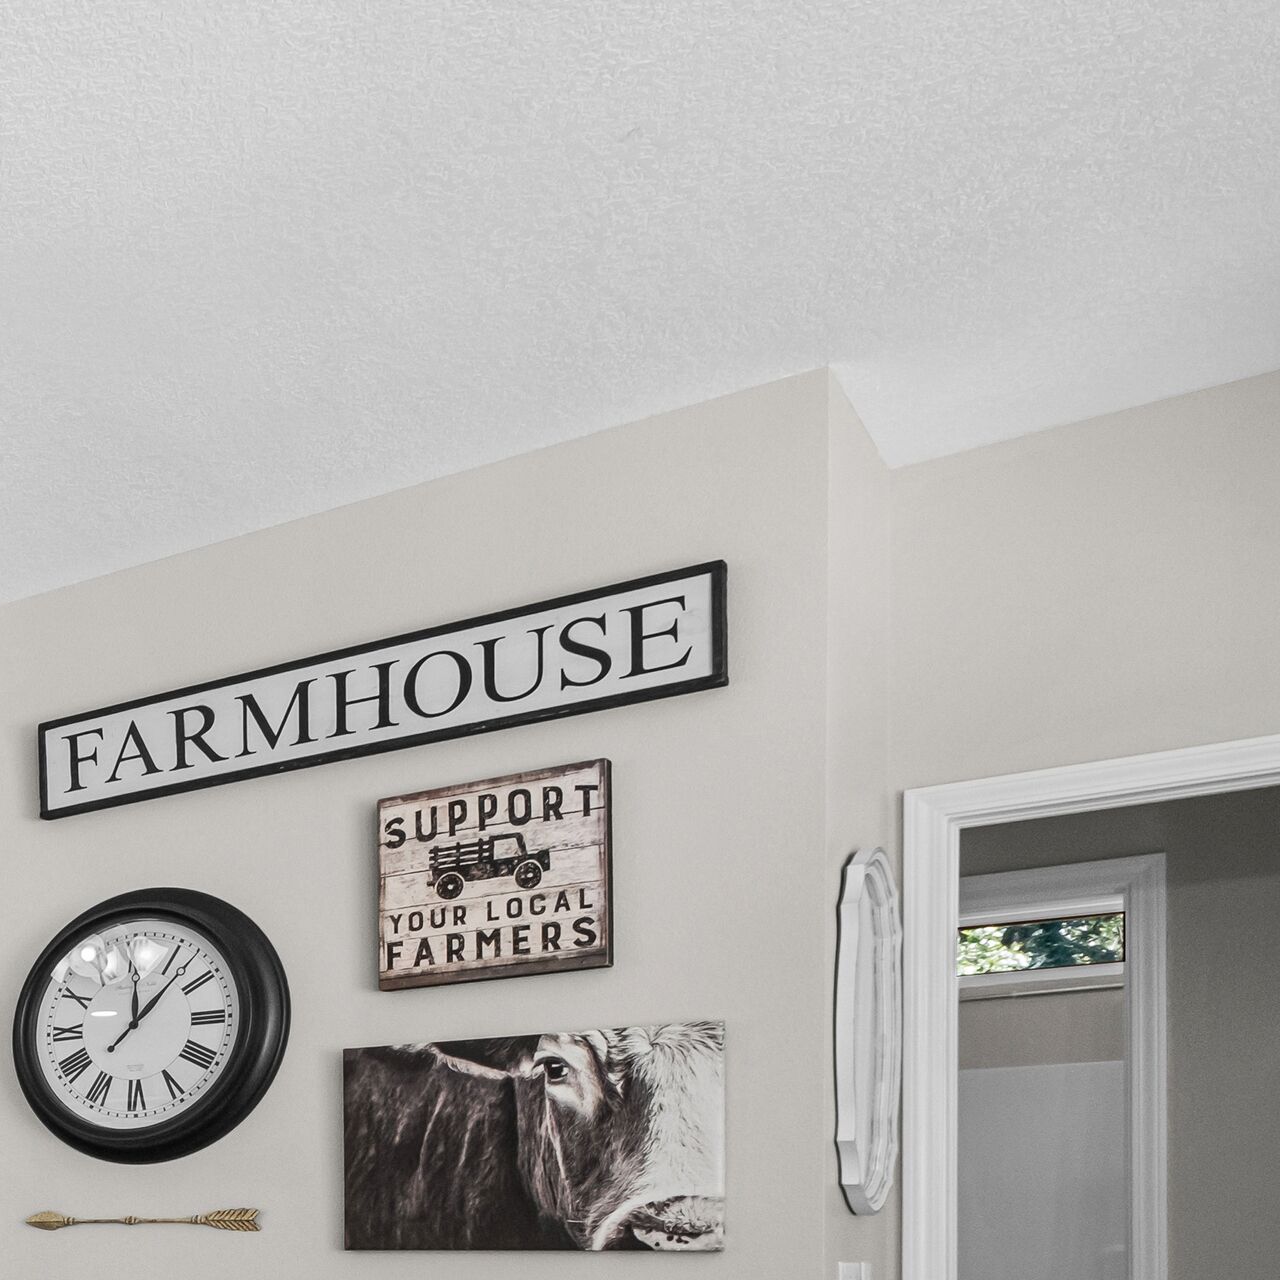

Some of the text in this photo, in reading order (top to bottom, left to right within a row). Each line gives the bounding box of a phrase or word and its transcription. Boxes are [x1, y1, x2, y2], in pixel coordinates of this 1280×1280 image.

[61, 594, 693, 794] FARMHOUSE
[384, 784, 599, 849] SUPPORT
[389, 888, 594, 934] YOUR LOCAL
[386, 916, 598, 970] FARMERS
